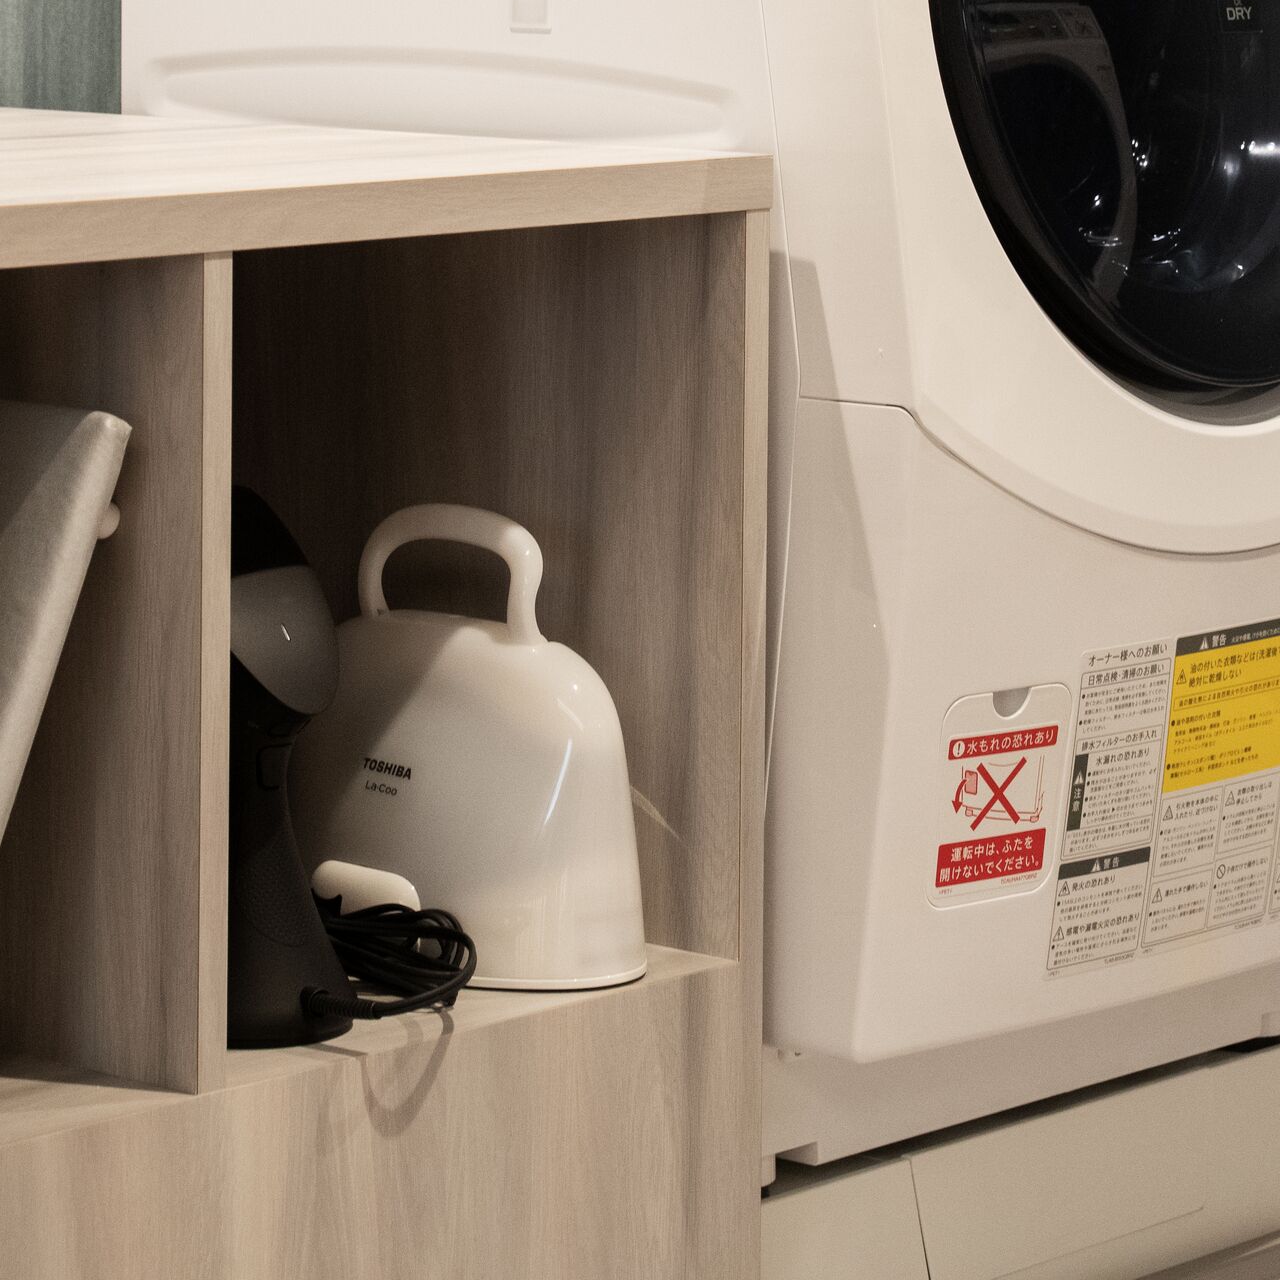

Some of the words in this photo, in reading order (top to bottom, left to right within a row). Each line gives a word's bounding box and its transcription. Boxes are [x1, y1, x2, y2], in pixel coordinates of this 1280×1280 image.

[1226, 7, 1252, 21] DRY
[1089, 643, 1168, 667] オーナー様へのお願い
[1088, 663, 1165, 686] 日常点検・清掃のお願い
[1189, 669, 1242, 688] 絶対に乾燥しない
[967, 729, 1055, 754] 水もれの恐れあり
[1082, 729, 1157, 752] 排水フィルターのお手入れ
[362, 757, 412, 780] TOSHIBA
[1096, 748, 1150, 766] 水漏れの恐れあり
[950, 836, 1034, 862] 運転中は、ふたを
[939, 855, 1040, 883] 開けないでください。
[1103, 856, 1120, 868] 警告
[1072, 875, 1116, 892] 発火の恐れあり
[1066, 913, 1140, 936] 感電や漏電火災の恐れあり
